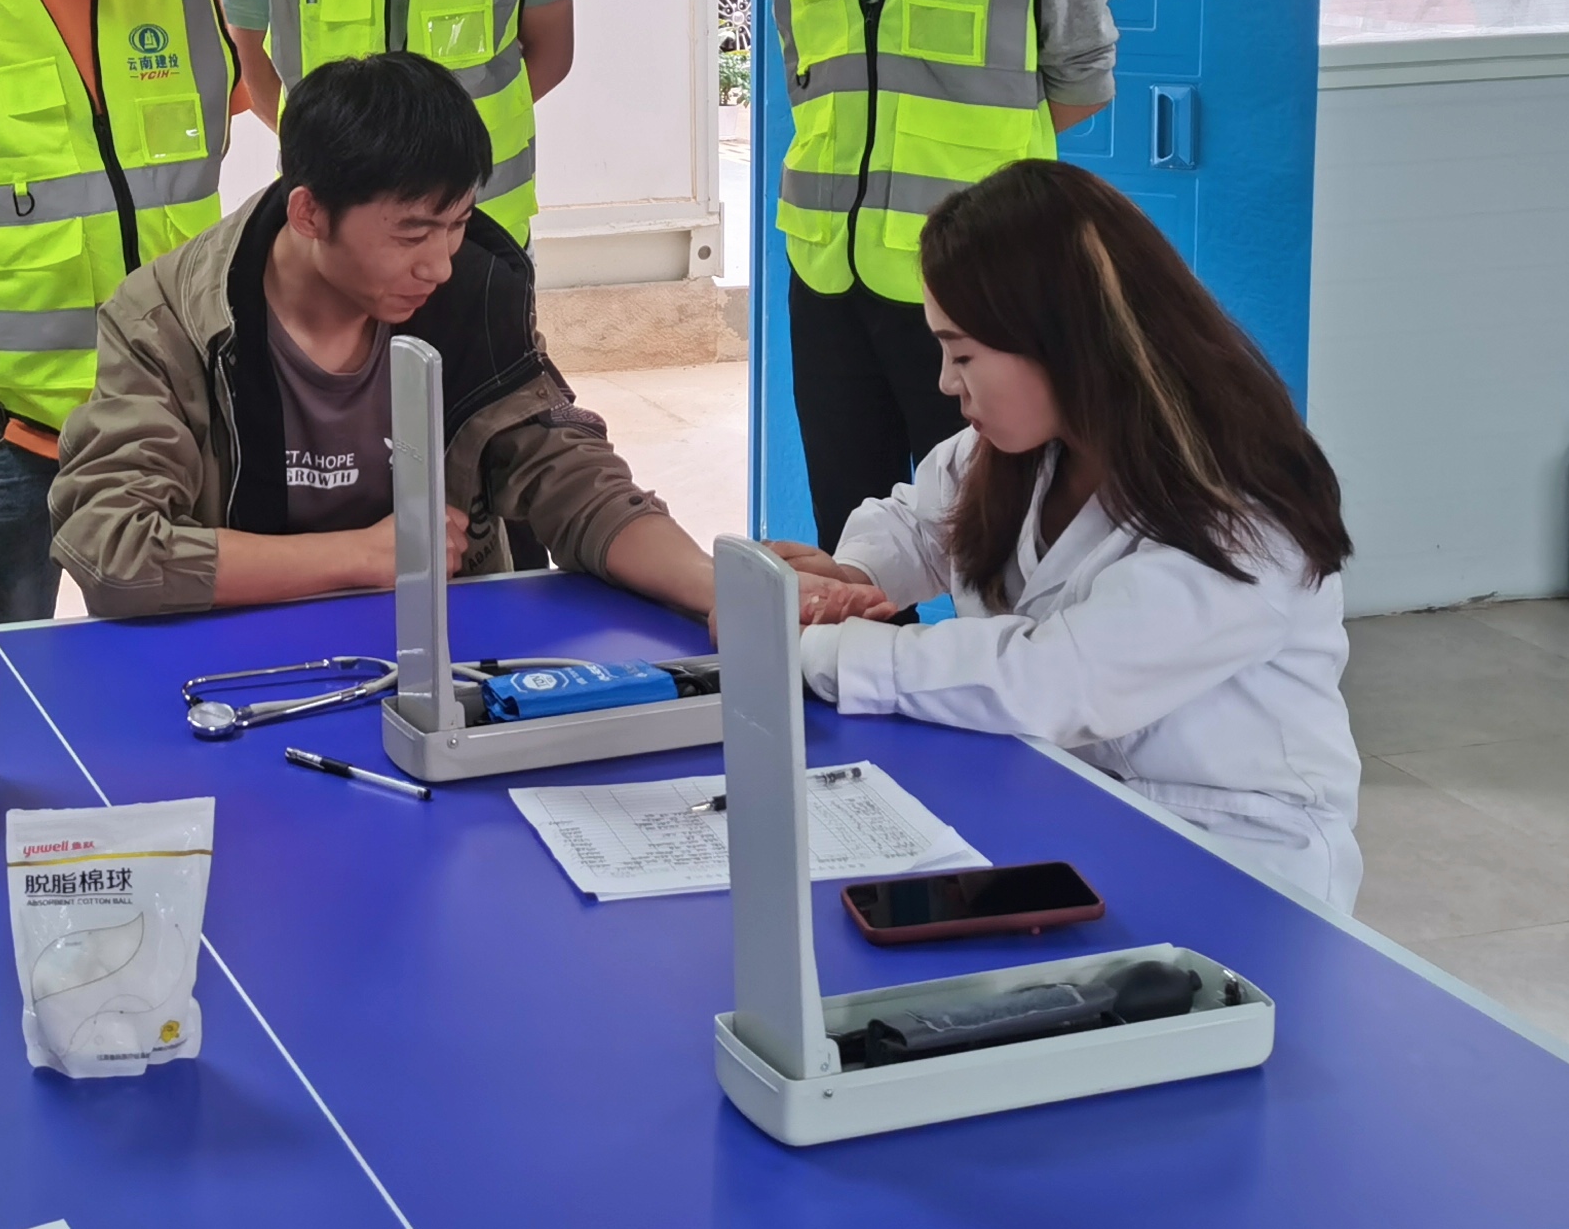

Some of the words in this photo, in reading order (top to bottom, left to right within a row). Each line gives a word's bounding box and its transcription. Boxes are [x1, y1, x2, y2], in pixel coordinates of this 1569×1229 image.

[127, 53, 180, 70] 云南建投
[140, 70, 170, 81] YCIH
[302, 451, 312, 466] A
[315, 453, 355, 469] HOPE
[23, 840, 69, 858] yuwell
[24, 867, 133, 894] 脱脂棉球
[27, 898, 75, 906] ABSORBENT
[77, 897, 111, 905] COTTON
[112, 897, 133, 905] BALL
